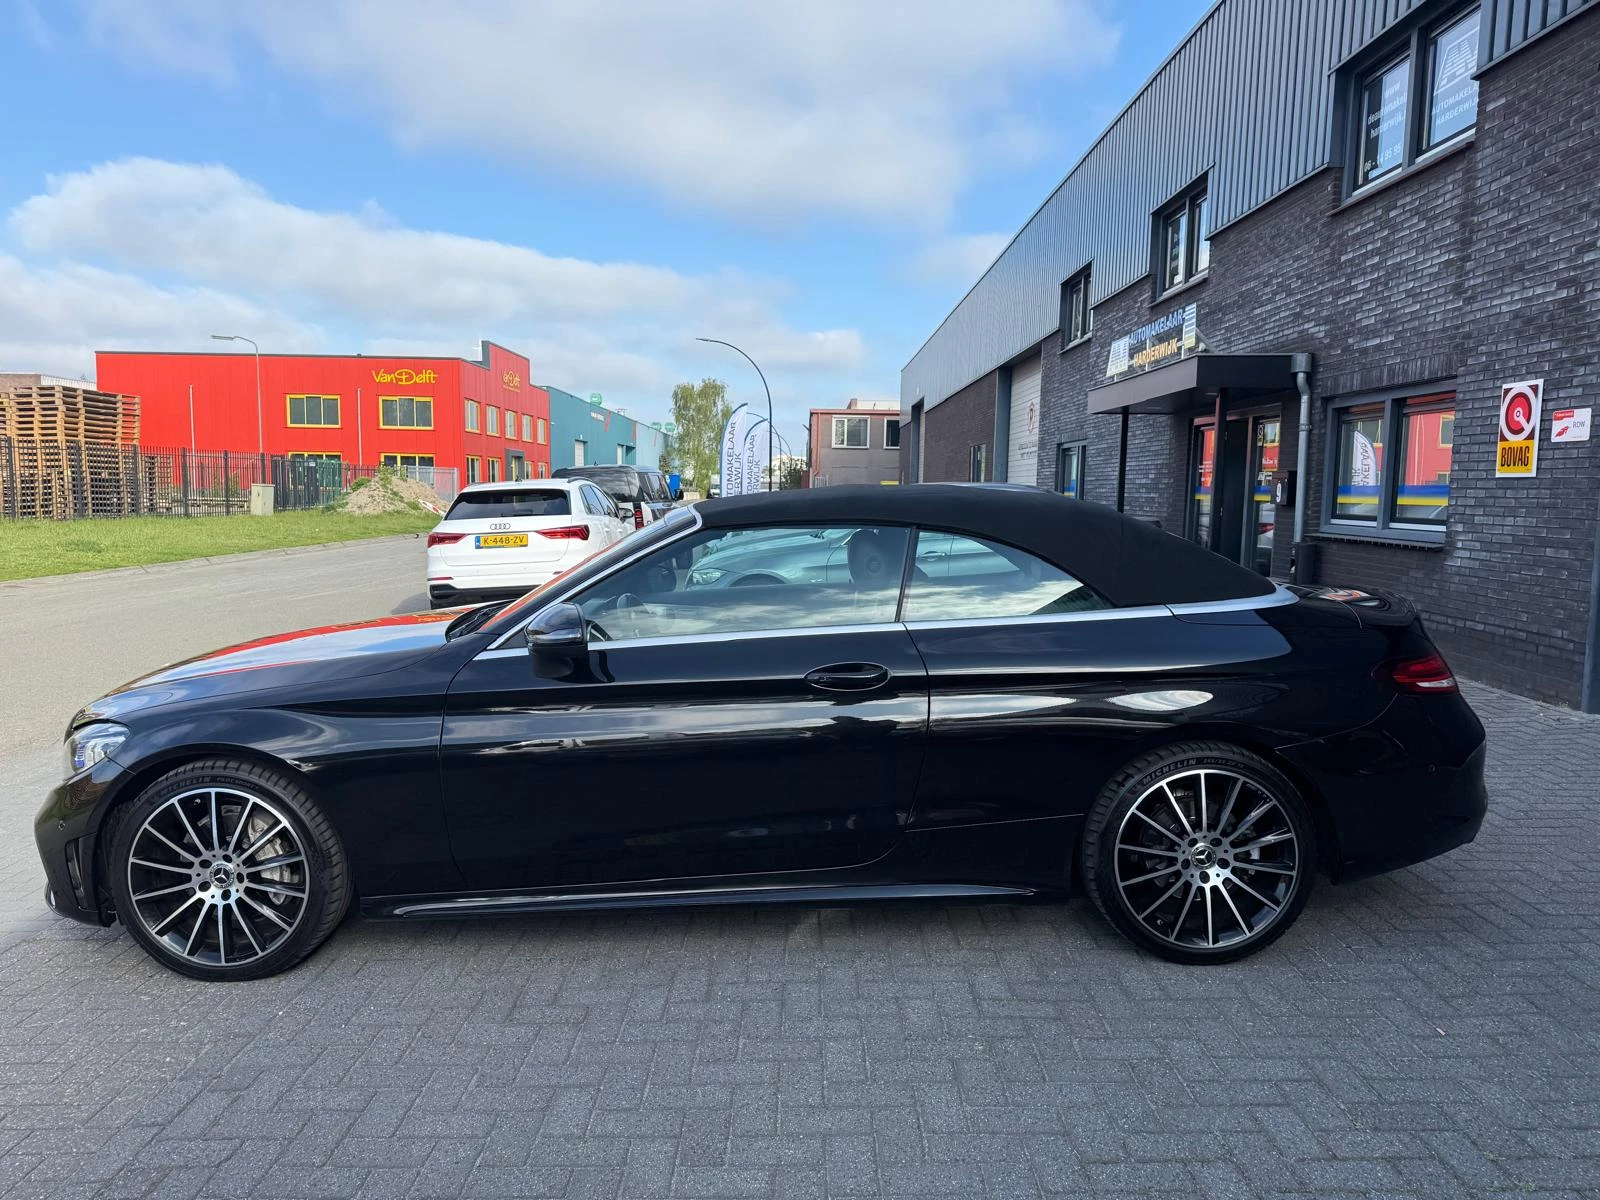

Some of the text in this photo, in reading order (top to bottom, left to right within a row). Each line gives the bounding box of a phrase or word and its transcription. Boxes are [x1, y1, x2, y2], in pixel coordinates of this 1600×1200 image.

[1133, 338, 1178, 367] HARDERWIJK
[1572, 420, 1586, 429] RDW
[1500, 446, 1530, 467] BOVAG
[1276, 483, 1282, 503] 9
[483, 535, 525, 545] K-448-ZV
[1142, 758, 1197, 785] MICHELIN
